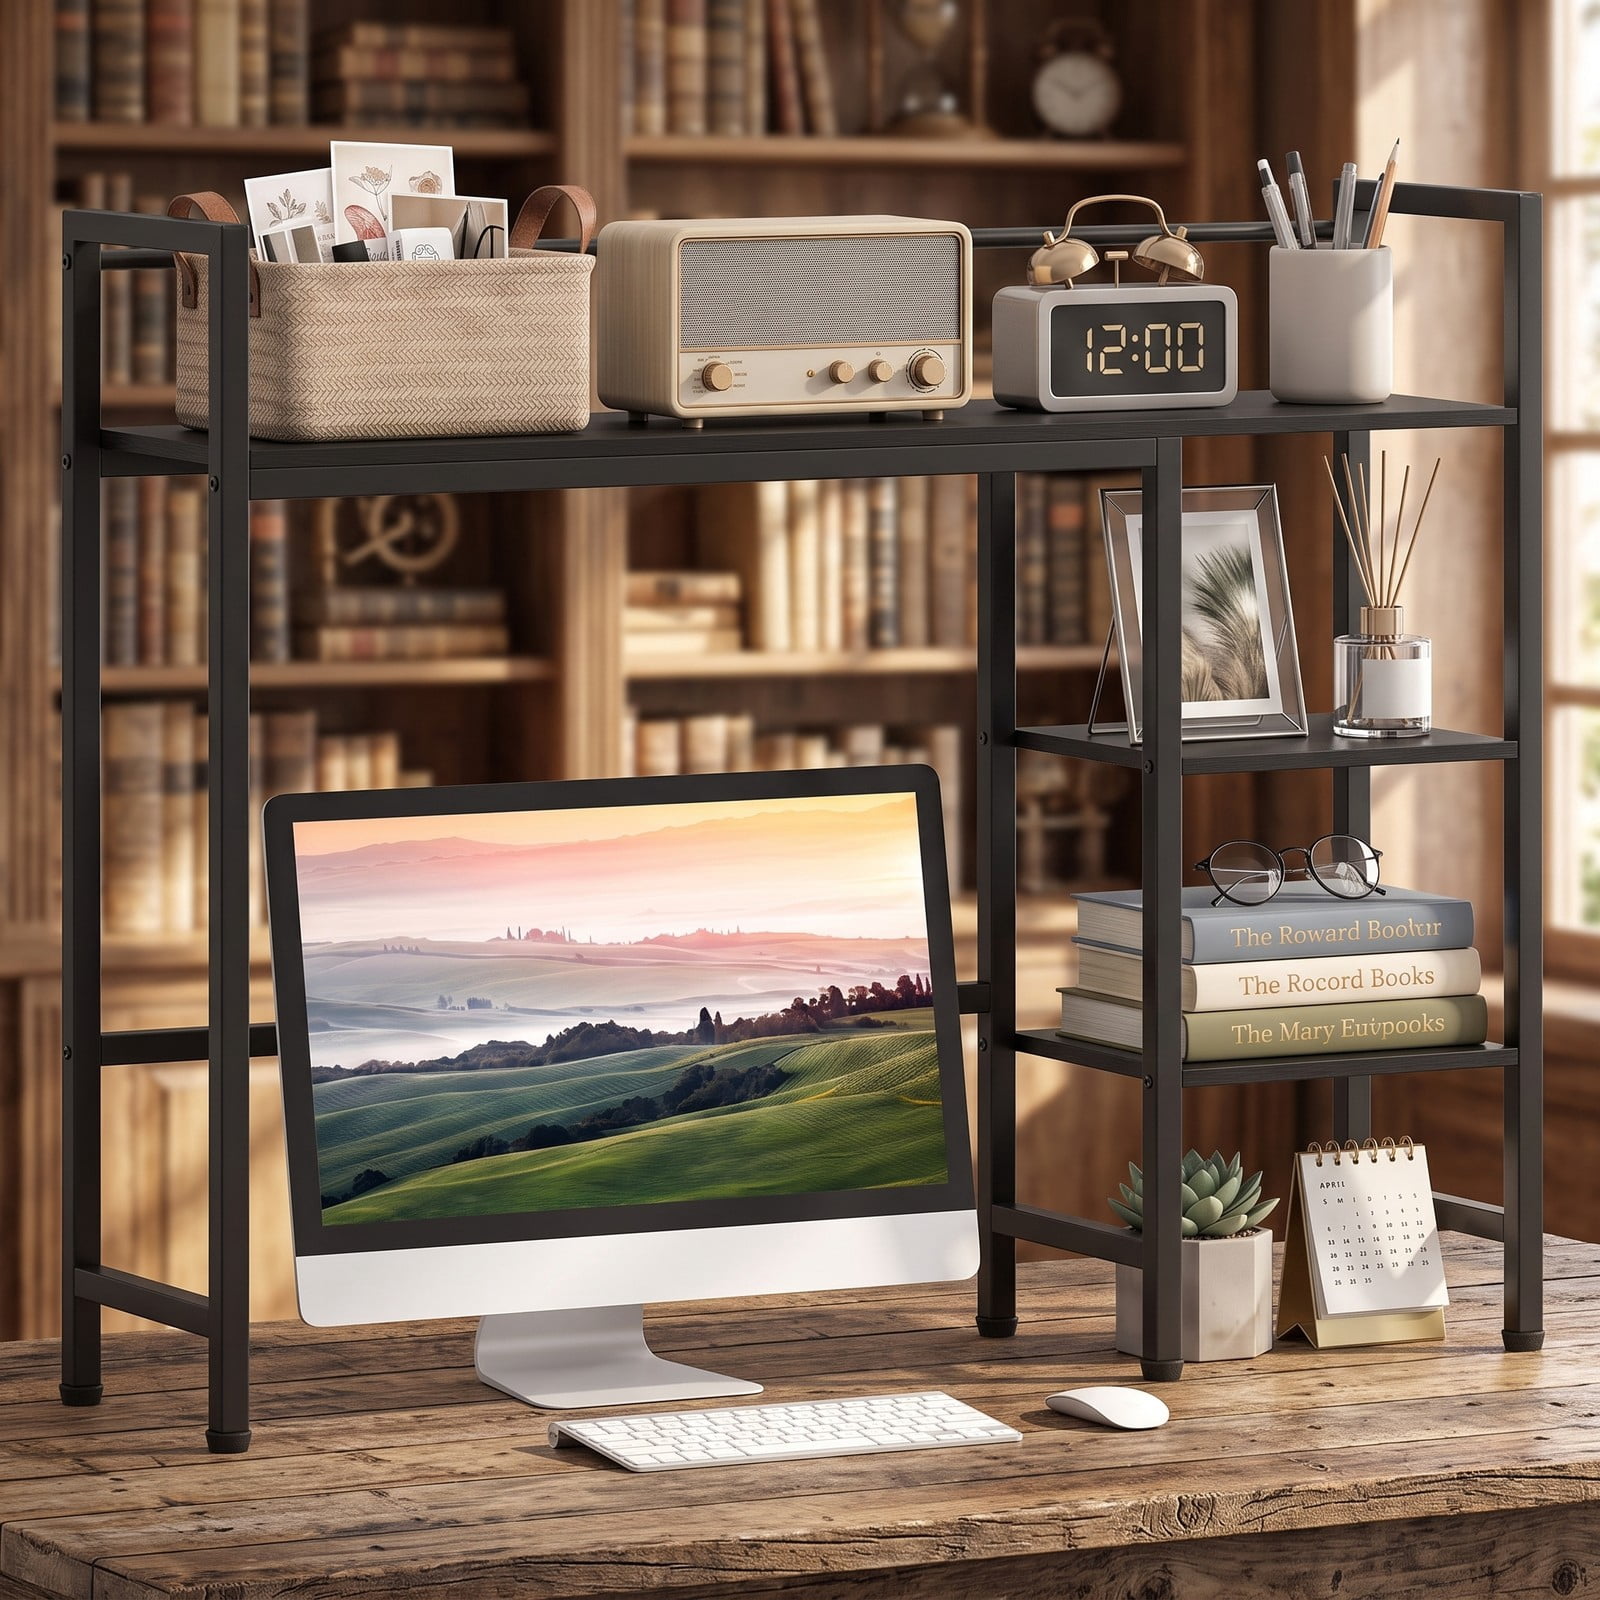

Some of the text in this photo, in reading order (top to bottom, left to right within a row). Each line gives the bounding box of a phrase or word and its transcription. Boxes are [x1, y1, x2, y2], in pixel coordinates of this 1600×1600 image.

[1086, 322, 1204, 375] 12:00
[1231, 927, 1272, 948] The
[1279, 920, 1360, 945] Roward
[1239, 966, 1435, 996] The Rocord Books
[1232, 1025, 1272, 1045] The
[1280, 1021, 1335, 1046] Mary
[1320, 1181, 1345, 1189] APRIL
